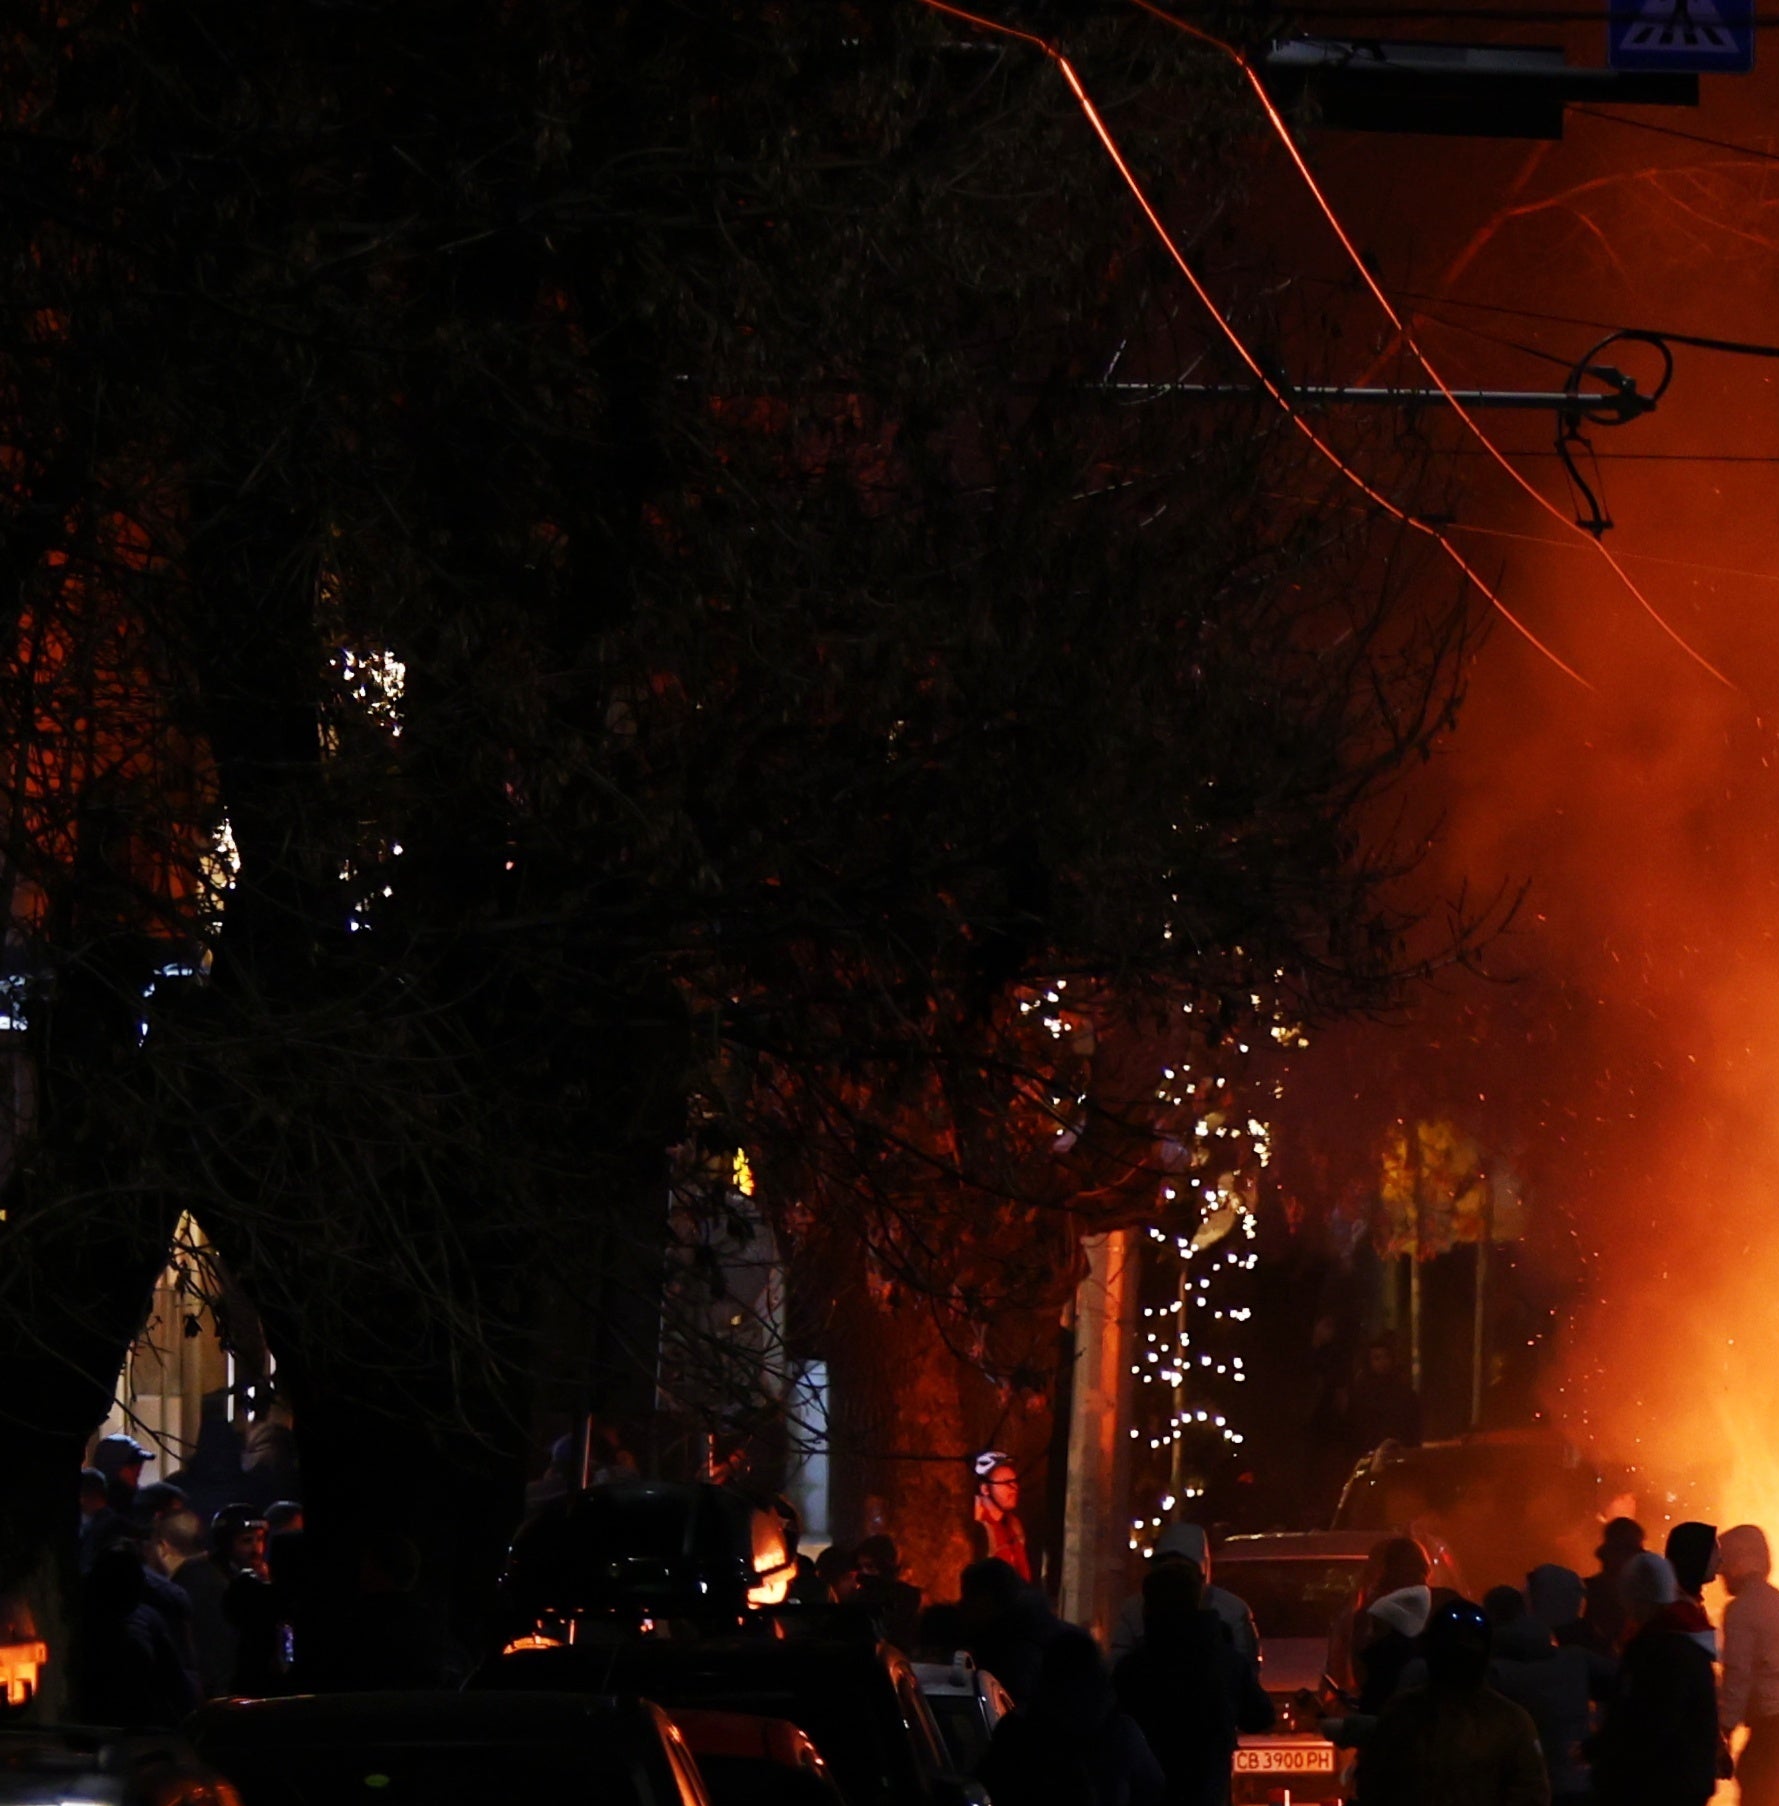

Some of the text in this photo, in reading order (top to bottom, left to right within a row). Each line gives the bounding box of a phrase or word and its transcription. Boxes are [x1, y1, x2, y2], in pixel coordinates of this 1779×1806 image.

[1237, 1752, 1329, 1769] CB 3900 PH
